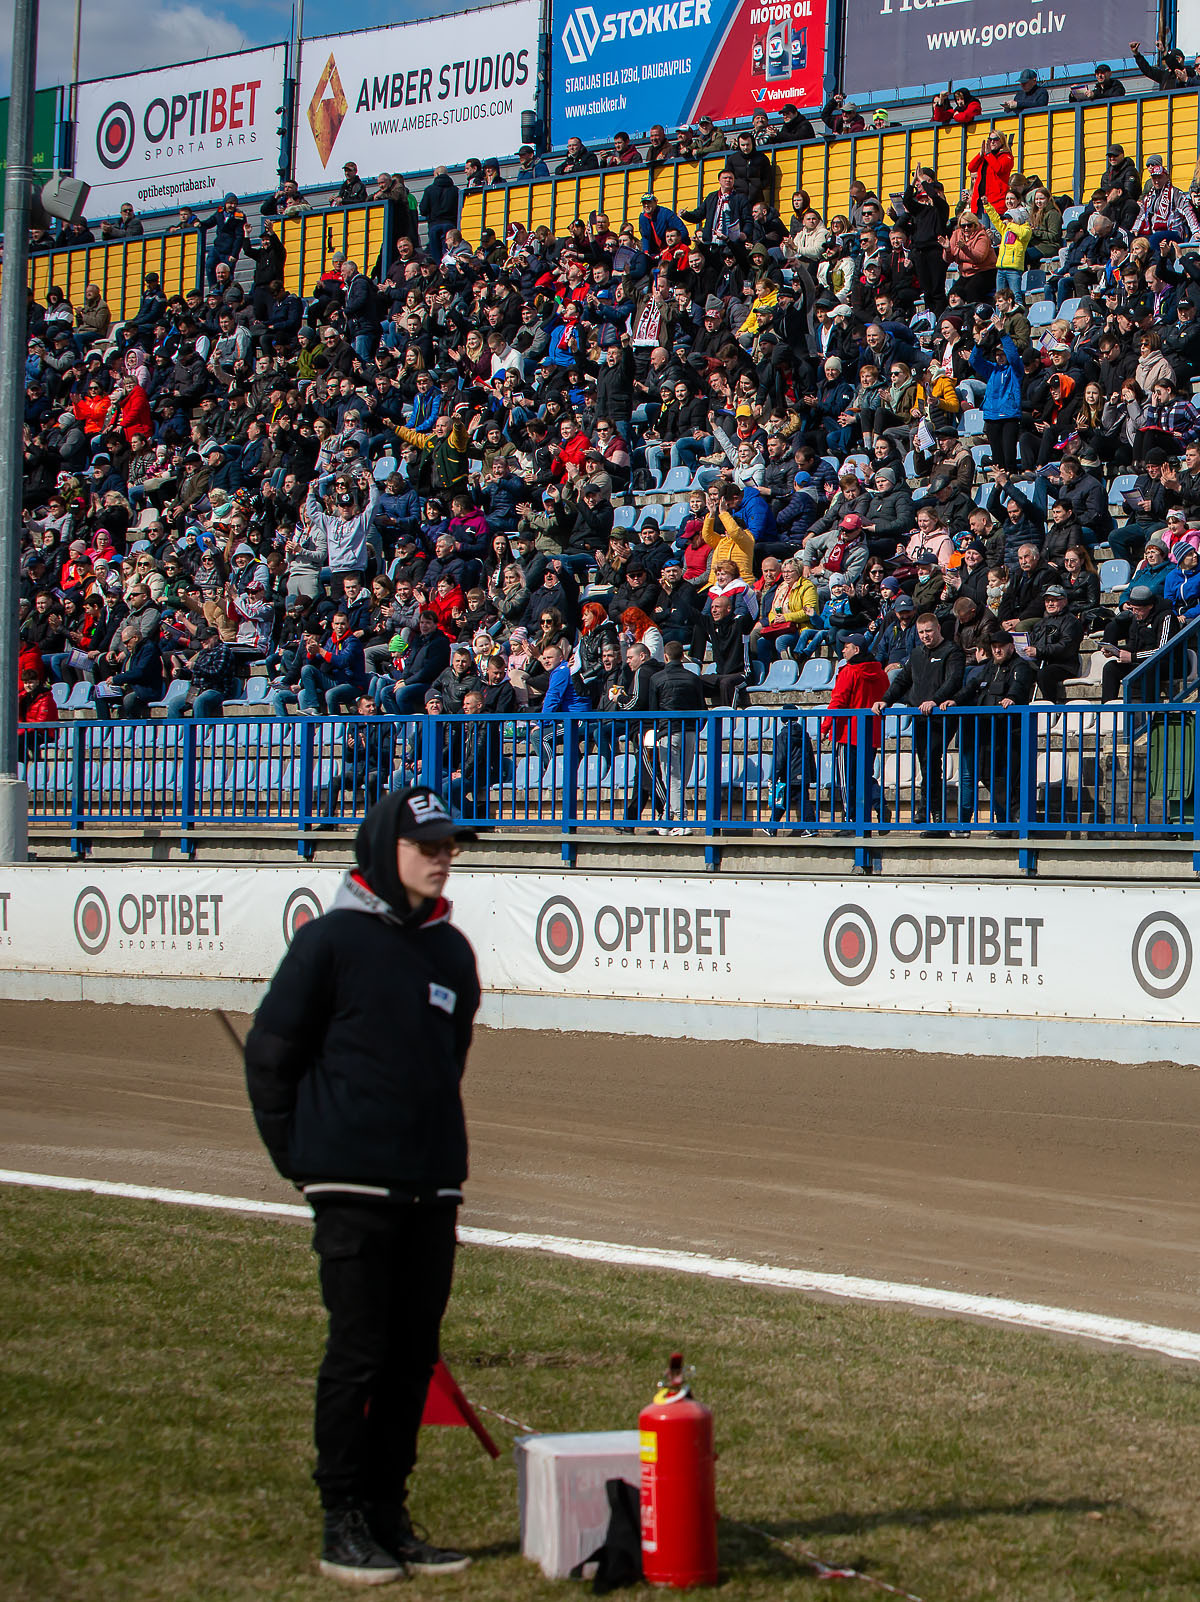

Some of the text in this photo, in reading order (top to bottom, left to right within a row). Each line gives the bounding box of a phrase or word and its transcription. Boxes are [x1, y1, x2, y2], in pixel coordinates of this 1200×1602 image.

[601, 0, 711, 42] STOKKER
[750, 1, 812, 24] MOTOR OIL
[927, 11, 1066, 50] www.gorod.lv
[355, 49, 529, 113] AMBER STUDIOS
[565, 58, 691, 93] STACIJAS IELA 129d, DAUGAVPILS
[144, 80, 262, 143] OPTIBET
[370, 98, 513, 136] WWW.AMBER-STUDIOS.COM
[565, 94, 627, 118] www.stokker.lv
[144, 131, 257, 161] SPORTA BĀRS
[137, 176, 216, 201] optibetsportabars.lv
[119, 894, 223, 935] OPTIBET
[594, 905, 731, 955] OPTIBET
[119, 938, 224, 951] SPORTA BĀRS
[889, 914, 1044, 967] OPTIBET
[594, 957, 732, 973] SPORTA BĀRS
[889, 969, 1044, 986] SPORTA BĀRS
